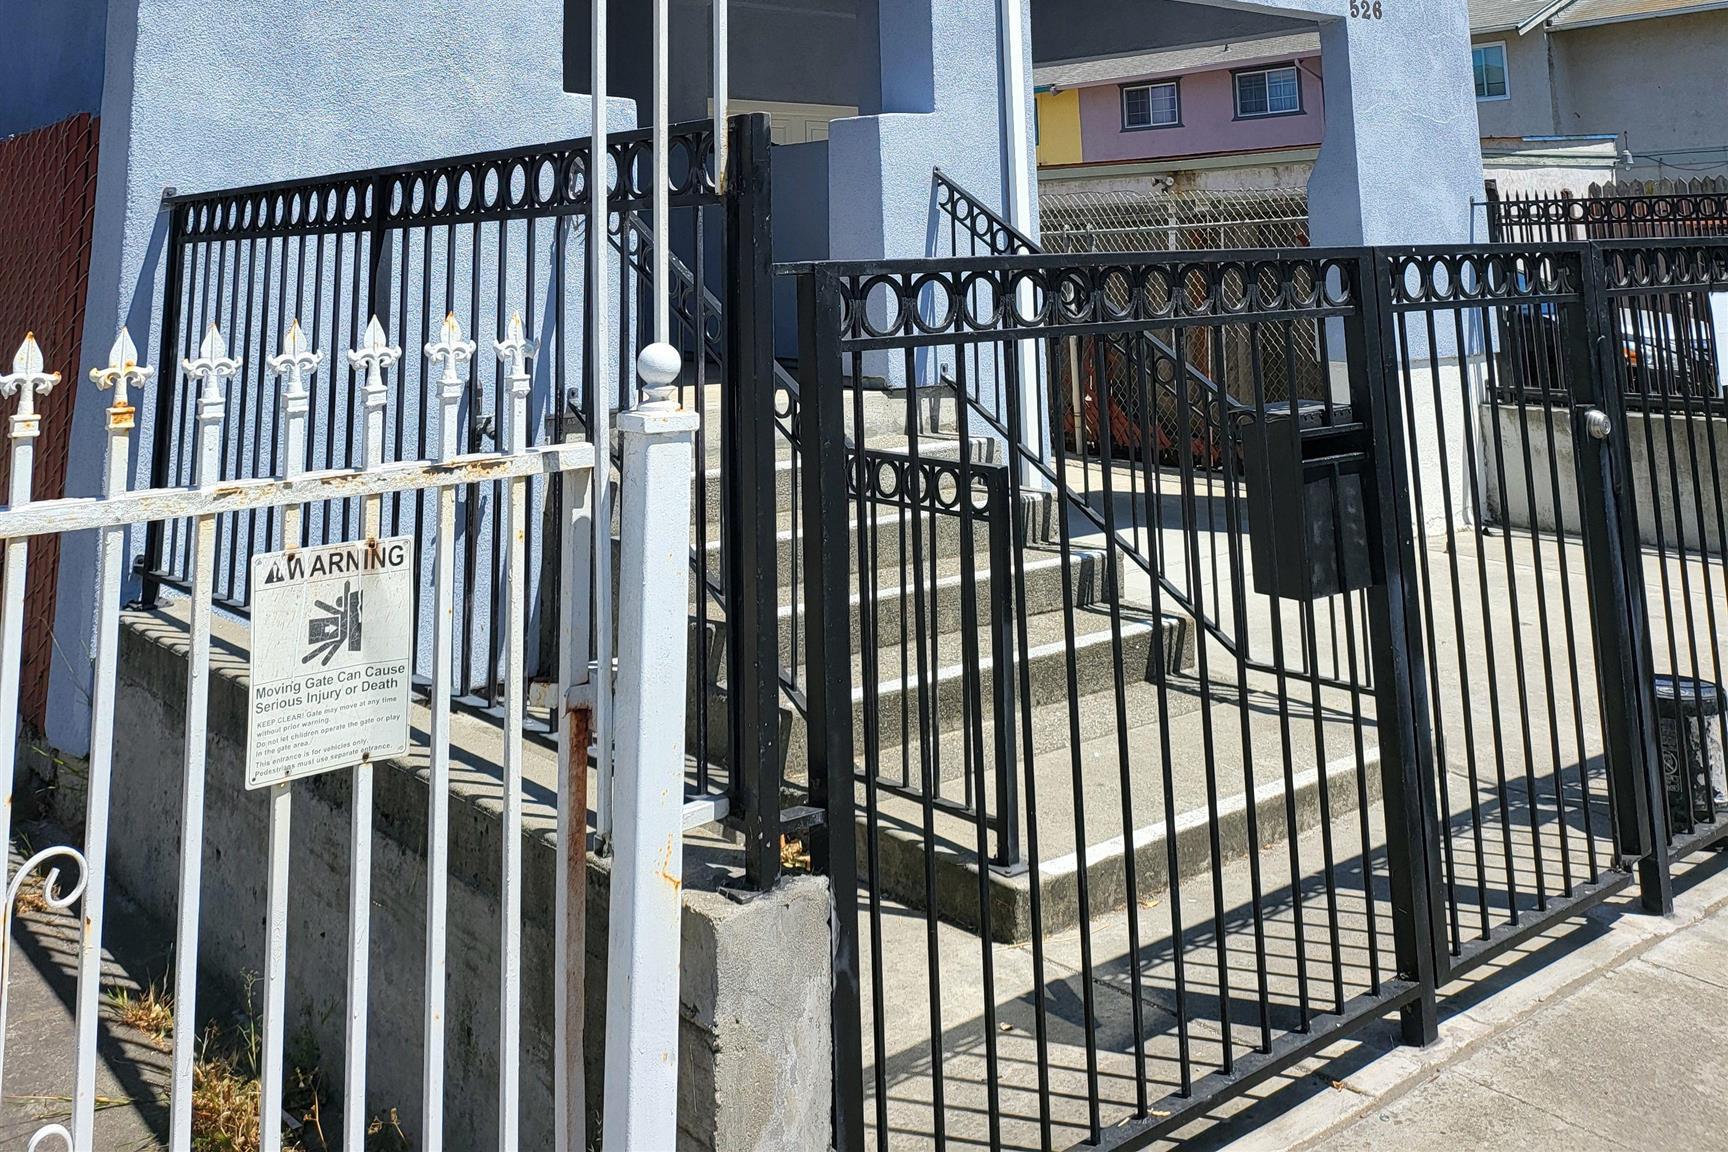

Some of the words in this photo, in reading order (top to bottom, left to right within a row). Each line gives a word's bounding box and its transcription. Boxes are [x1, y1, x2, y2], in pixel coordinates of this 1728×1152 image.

[287, 545, 404, 580] WARNING
[255, 681, 301, 700] Moving
[305, 675, 334, 689] Gate
[337, 671, 361, 682] Can
[365, 665, 405, 678] Cause
[255, 696, 303, 714] Serious
[306, 688, 341, 704] Injury
[345, 685, 358, 695] or
[361, 678, 398, 692] Death
[257, 718, 276, 728] KEEP
[277, 713, 305, 724] CLEAR!
[306, 710, 322, 718] Gate
[340, 702, 357, 710] move
[257, 726, 281, 737] without
[283, 722, 300, 732] prior
[302, 717, 330, 728] warning.
[267, 737, 279, 745] not
[280, 734, 289, 742] let
[290, 729, 319, 740] children
[320, 723, 345, 734] operate
[360, 717, 374, 726] gate
[385, 714, 401, 723] play
[255, 759, 270, 768] This
[272, 752, 302, 765] entrance
[323, 741, 351, 753] vehicles
[352, 737, 369, 747] only.
[255, 762, 296, 776] Pedestrians
[297, 757, 315, 767] must
[316, 754, 328, 763] use
[330, 748, 359, 760] separate
[360, 743, 393, 753] entrance.
[277, 744, 291, 754] gate
